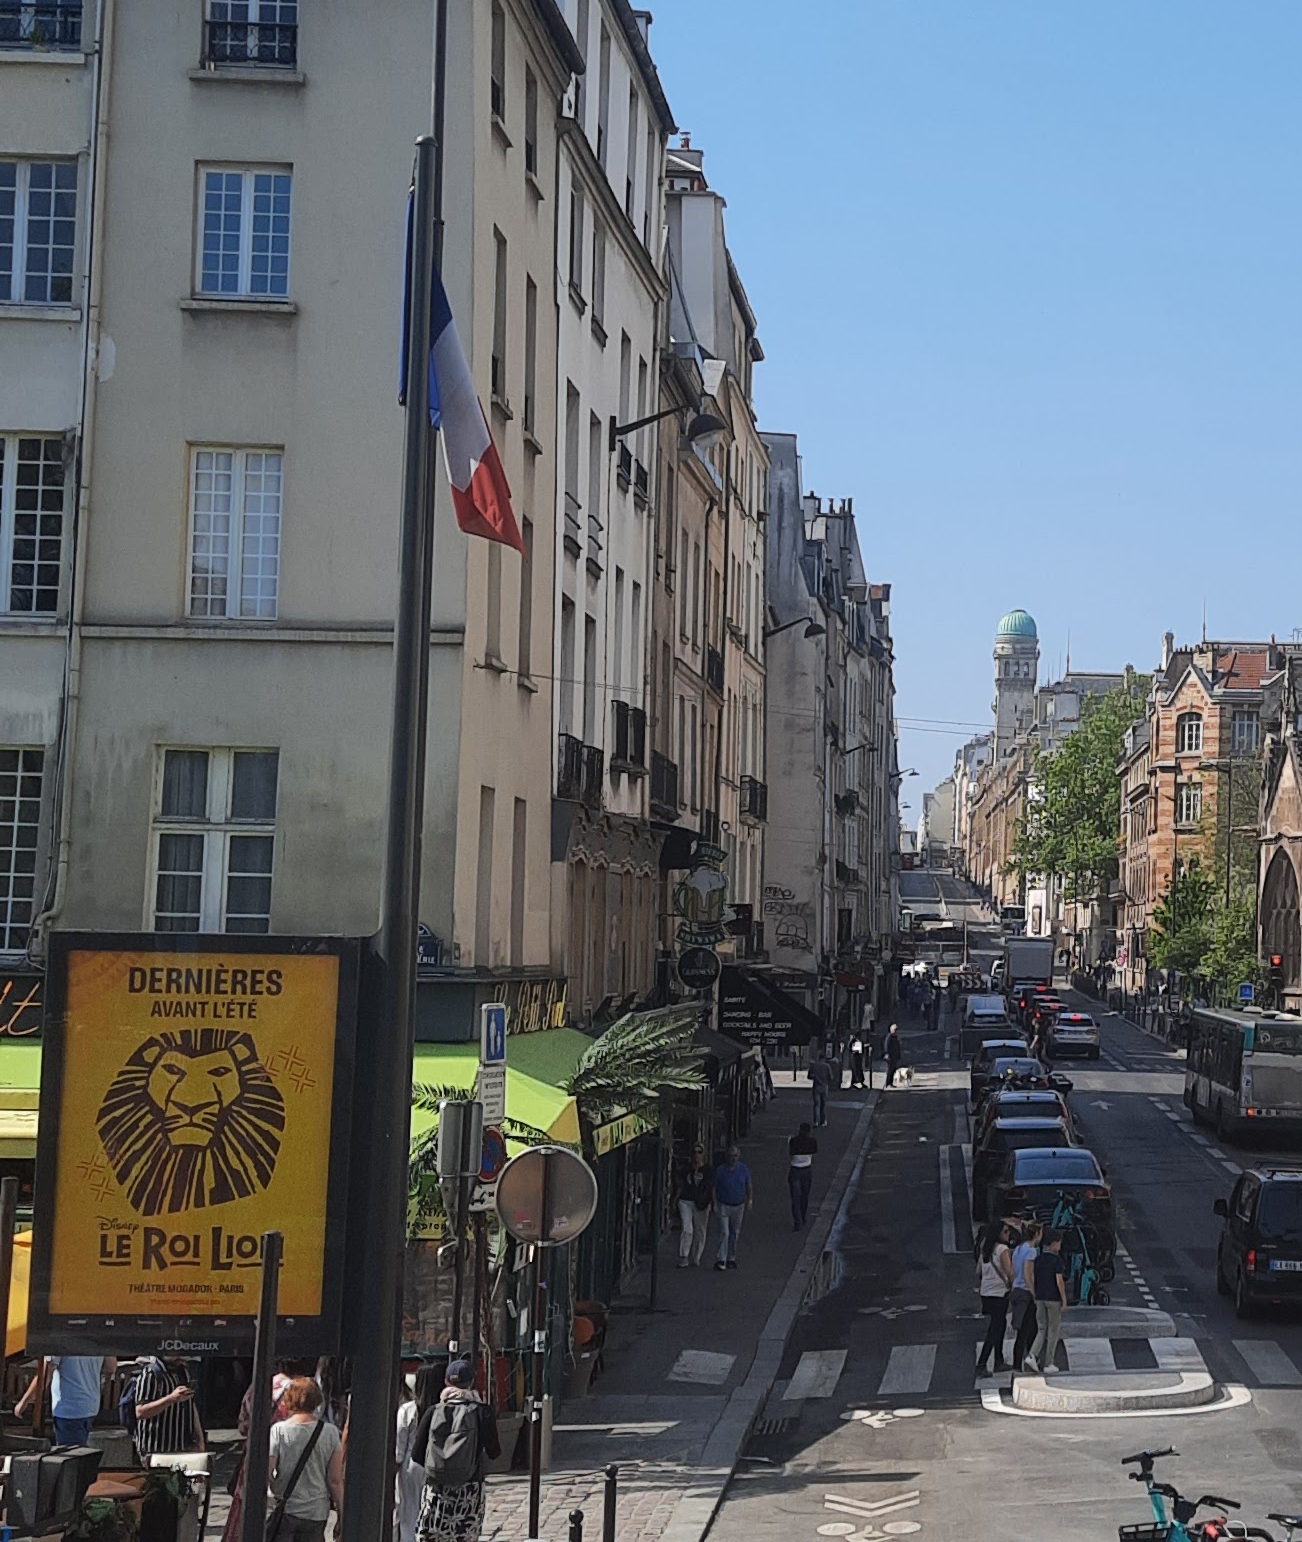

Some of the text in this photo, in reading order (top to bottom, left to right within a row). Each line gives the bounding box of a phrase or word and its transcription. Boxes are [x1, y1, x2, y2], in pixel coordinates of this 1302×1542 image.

[128, 963, 283, 996] DERNIÈRES
[150, 998, 258, 1019] AVANT L'ÉTÉ
[96, 1216, 139, 1234] Disney
[99, 1233, 132, 1263] LE
[157, 1339, 220, 1351] JCDecaux
